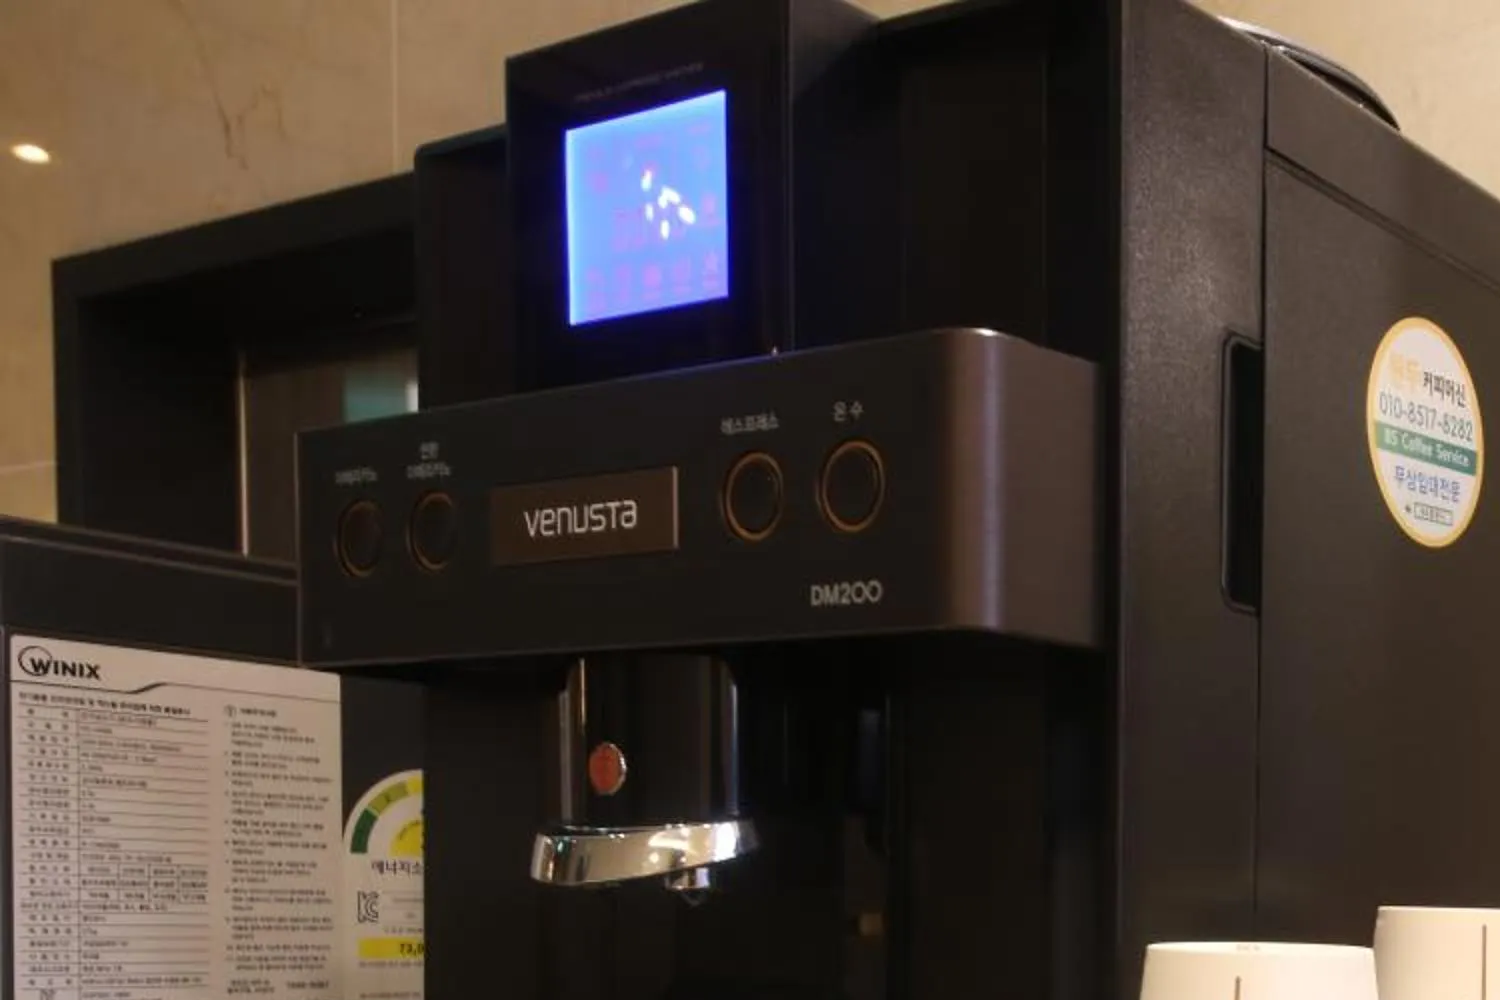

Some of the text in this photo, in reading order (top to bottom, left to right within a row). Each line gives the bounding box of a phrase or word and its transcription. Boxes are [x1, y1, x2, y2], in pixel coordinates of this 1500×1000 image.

[1423, 370, 1466, 409] 커피머신
[811, 580, 882, 606] DM200
[29, 656, 101, 681] WINIX
